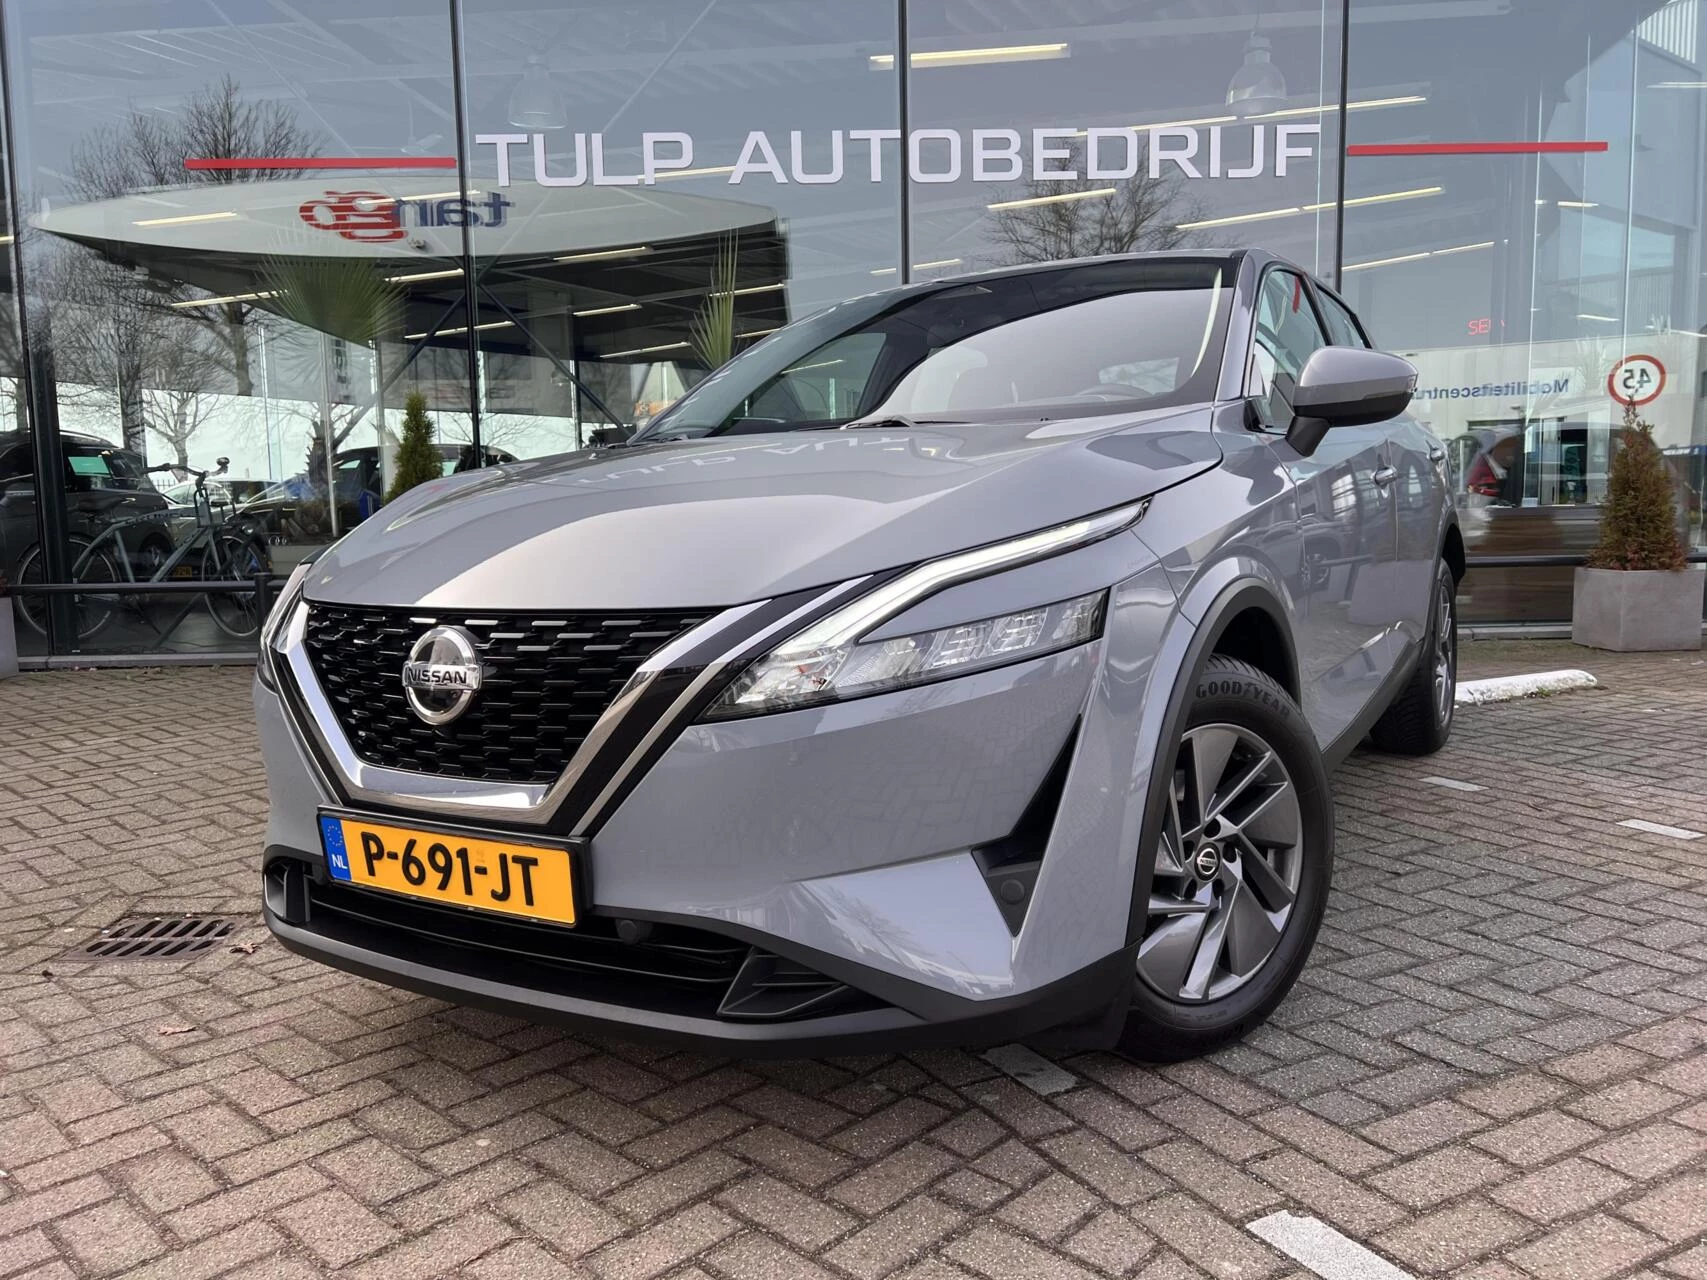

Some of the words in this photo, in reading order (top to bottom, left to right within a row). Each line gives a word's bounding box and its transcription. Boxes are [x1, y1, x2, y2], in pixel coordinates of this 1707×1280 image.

[475, 132, 694, 187] TULP
[728, 124, 1321, 185] AUTOBEDRIJF
[405, 666, 468, 685] NISSAN
[1195, 680, 1291, 719] GOODYEAR
[332, 854, 348, 870] NL
[360, 831, 539, 907] P-691-JT
